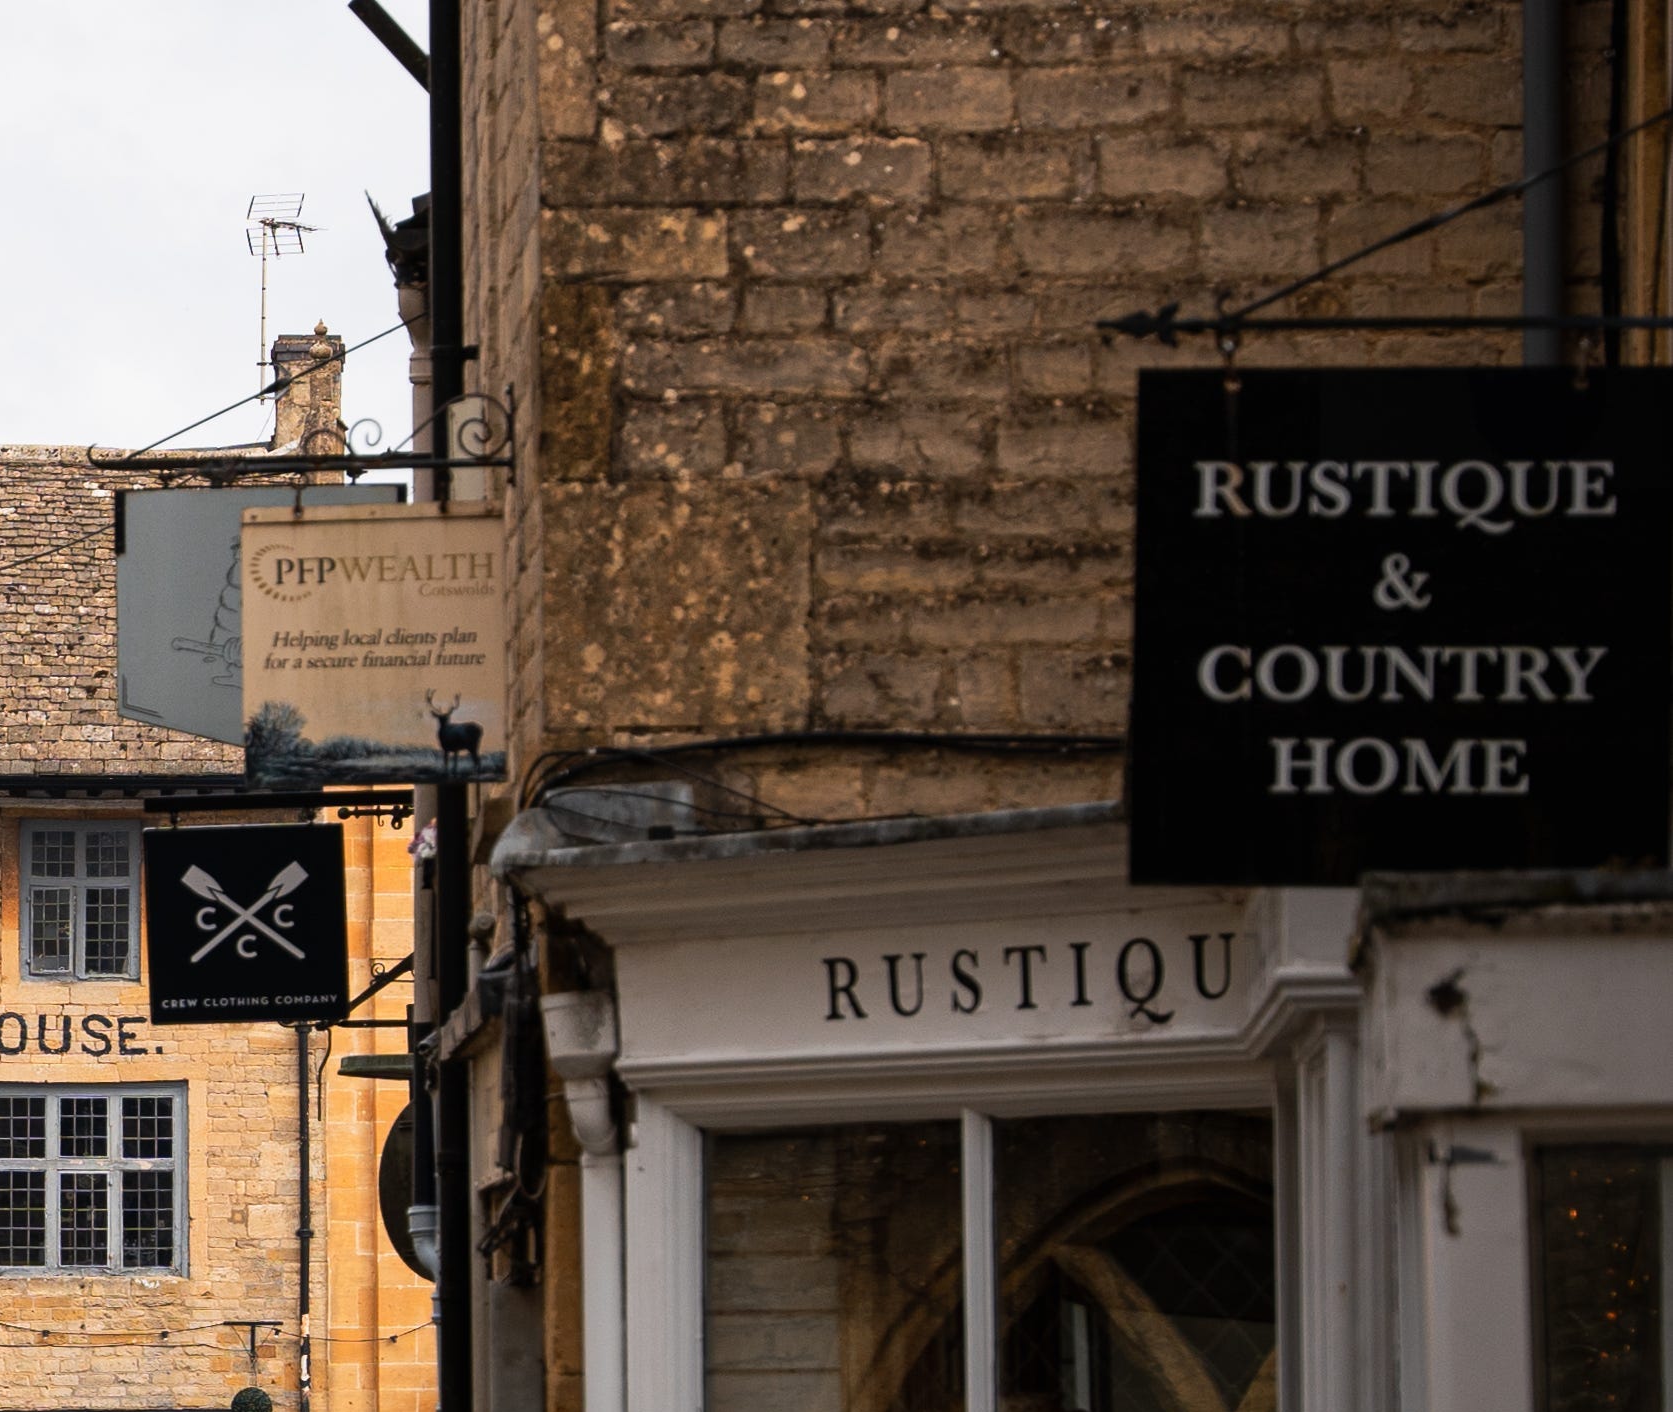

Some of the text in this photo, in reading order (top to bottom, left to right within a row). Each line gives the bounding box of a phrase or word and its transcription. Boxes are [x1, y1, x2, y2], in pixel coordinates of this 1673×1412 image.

[1193, 460, 1617, 535] RUSTIQUE
[419, 582, 495, 597] Cotswolds
[1373, 552, 1432, 611] &
[272, 627, 477, 650] Helping local clients plan
[263, 650, 486, 671] for a secure financial future
[1196, 644, 1610, 702] COUNTRY
[1268, 737, 1530, 795] HOME
[196, 904, 294, 931] C C
[236, 935, 257, 958] C
[822, 932, 1236, 1025] RUSTIQU
[161, 994, 338, 1009] CREW CLOTHING COMPANY
